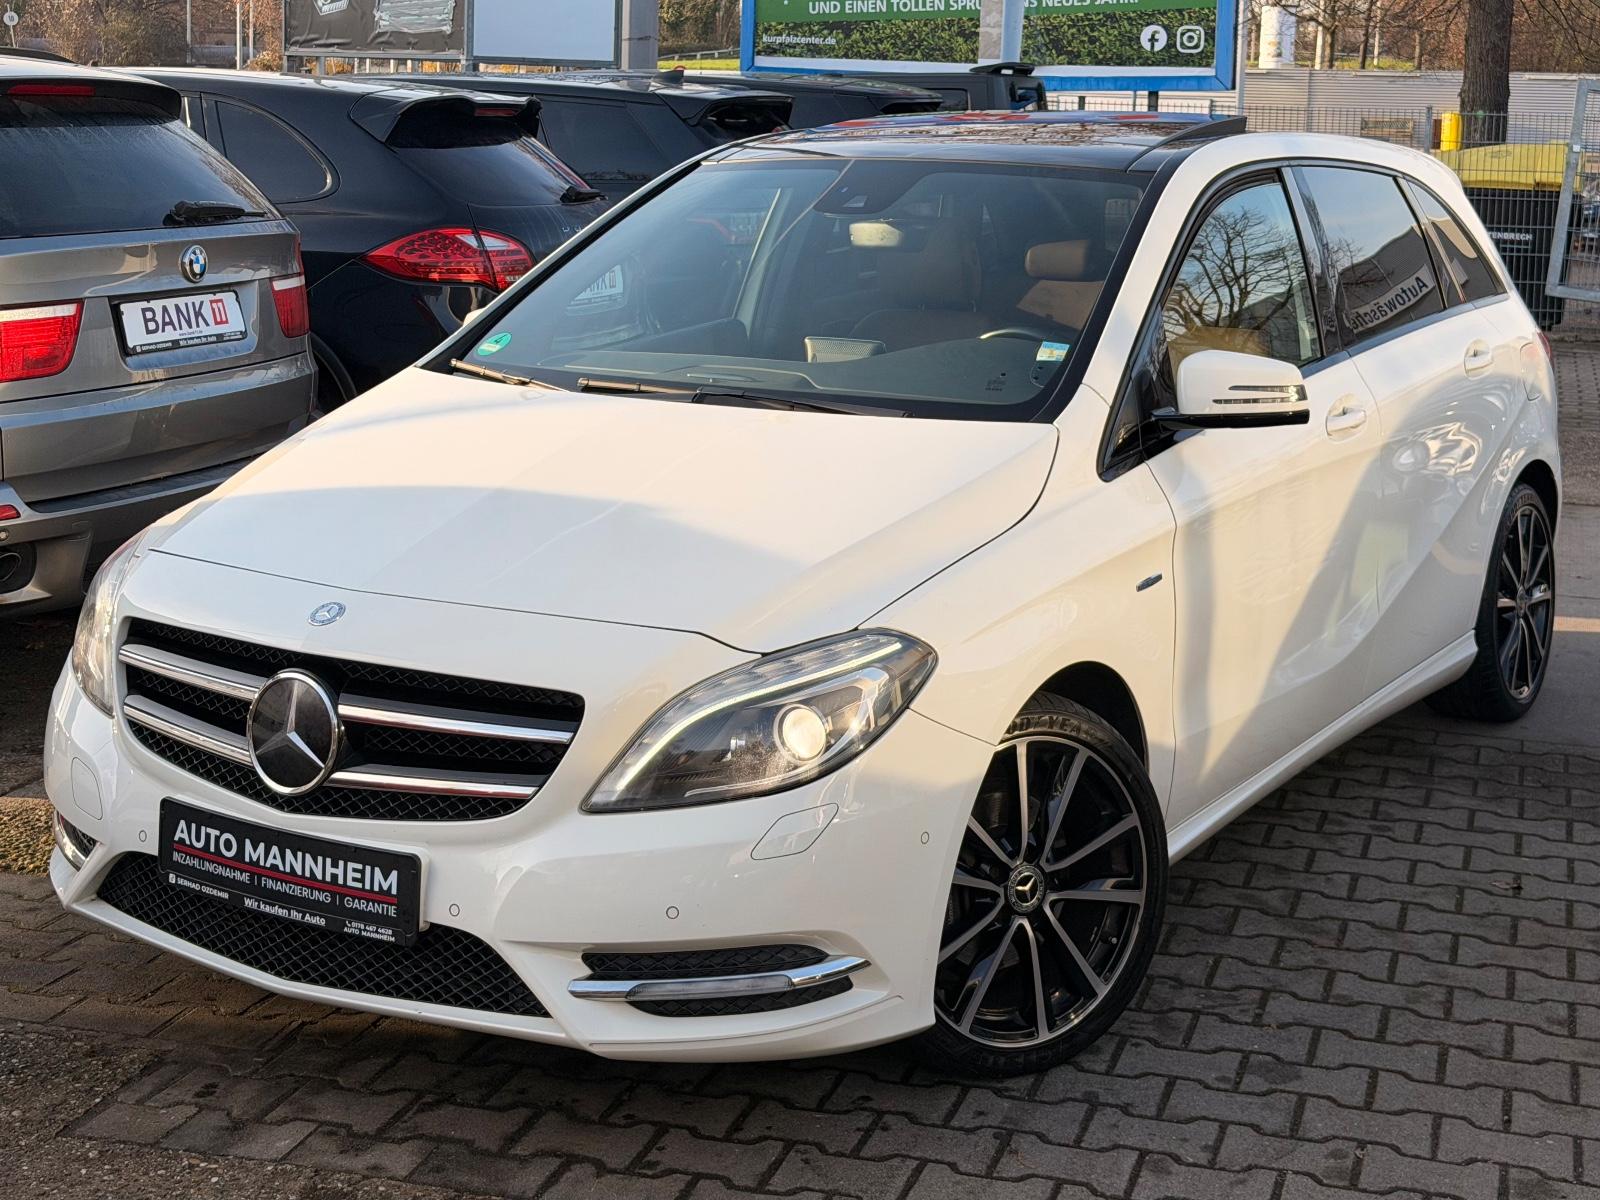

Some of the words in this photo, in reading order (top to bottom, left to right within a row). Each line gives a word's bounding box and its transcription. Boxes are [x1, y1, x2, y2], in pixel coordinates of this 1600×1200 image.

[808, 1, 841, 15] UND
[844, 0, 887, 14] EINEN
[890, 0, 945, 13] TOLLEN
[762, 33, 837, 46] kurpfalzcenter.de
[141, 301, 210, 335] BANK
[173, 819, 238, 858] AUTO
[244, 838, 398, 895] MANNHEIM
[172, 850, 250, 884] INZAHLUNGNAHME
[261, 877, 332, 904] FINANZIERUNG
[344, 897, 398, 918] GARANTIE
[176, 877, 201, 891] SERHAD
[243, 897, 258, 909] Wir
[259, 902, 289, 917] kaufen
[290, 909, 302, 920] Ihr
[304, 913, 326, 926] Auto
[343, 926, 360, 935] AUTO
[361, 930, 396, 943] MANNHEIM
